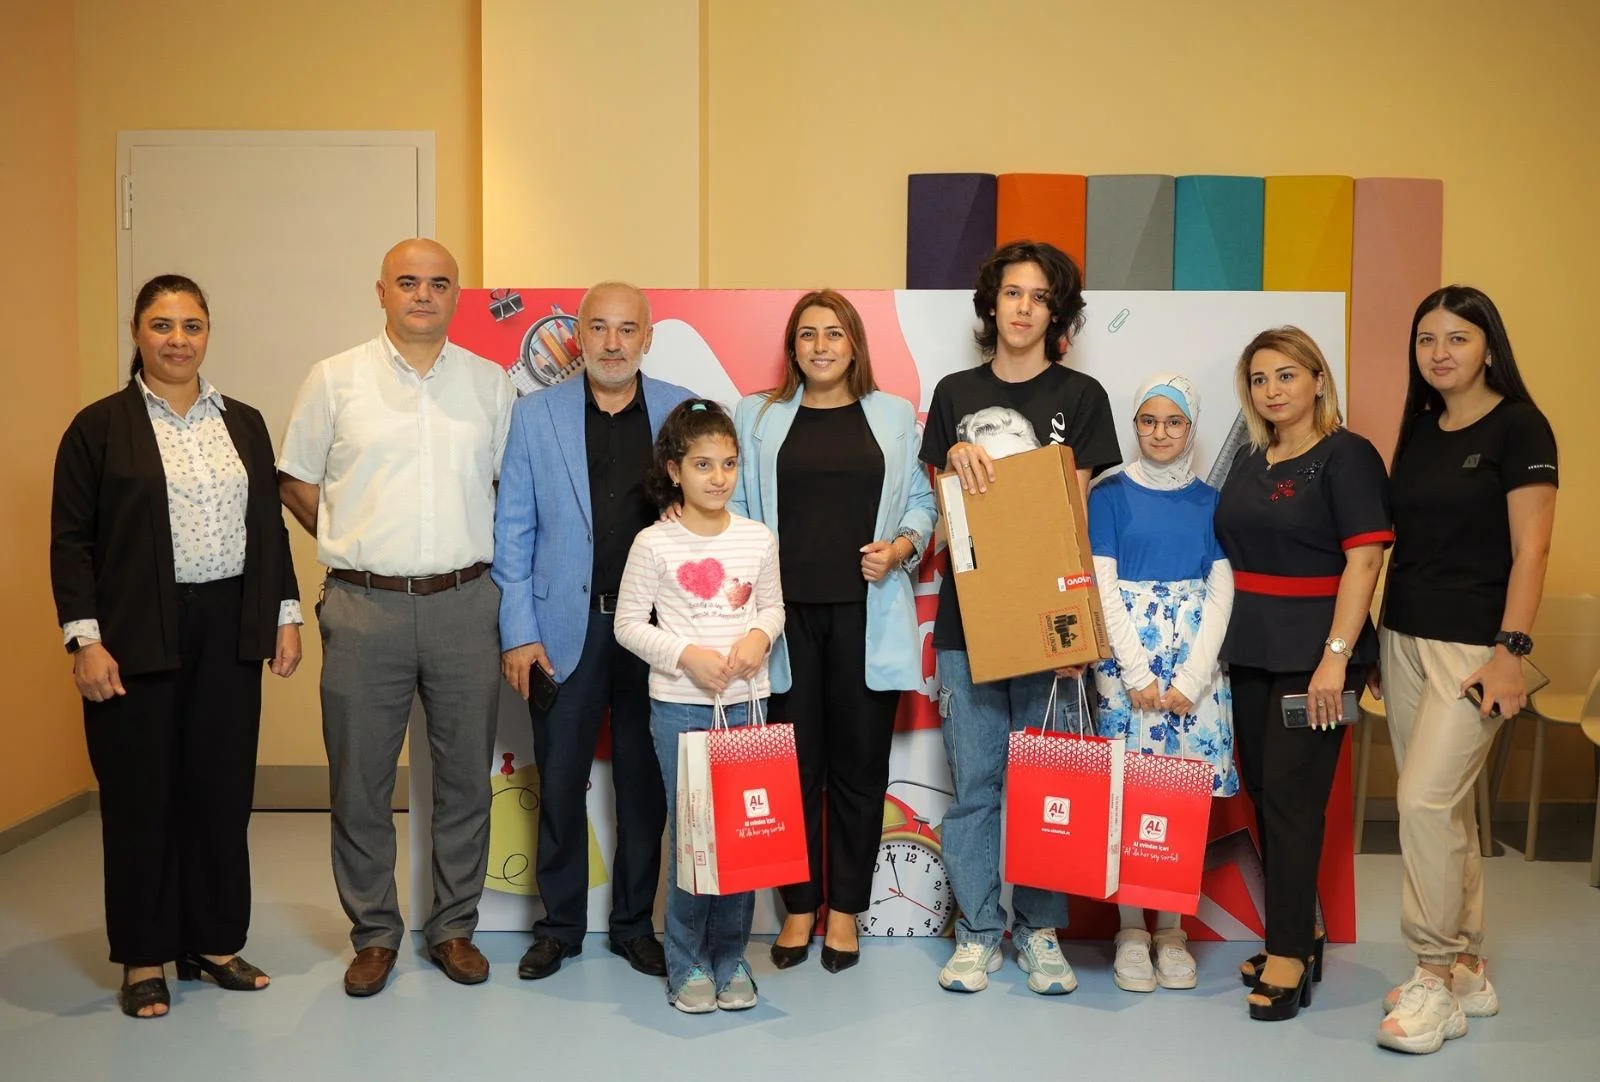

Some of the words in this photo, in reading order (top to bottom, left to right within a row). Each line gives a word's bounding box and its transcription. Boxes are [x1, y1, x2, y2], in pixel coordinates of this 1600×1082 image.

[749, 794, 764, 807] AL
[1048, 802, 1065, 814] AL
[1145, 820, 1161, 832] AL
[885, 853, 897, 863] 11
[905, 852, 918, 863] 12
[924, 863, 931, 873] 1
[934, 881, 942, 891] 2
[934, 901, 942, 911] 3
[870, 917, 878, 926] 7
[924, 917, 932, 928] 4
[886, 927, 894, 937] 6
[906, 927, 914, 937] 5
